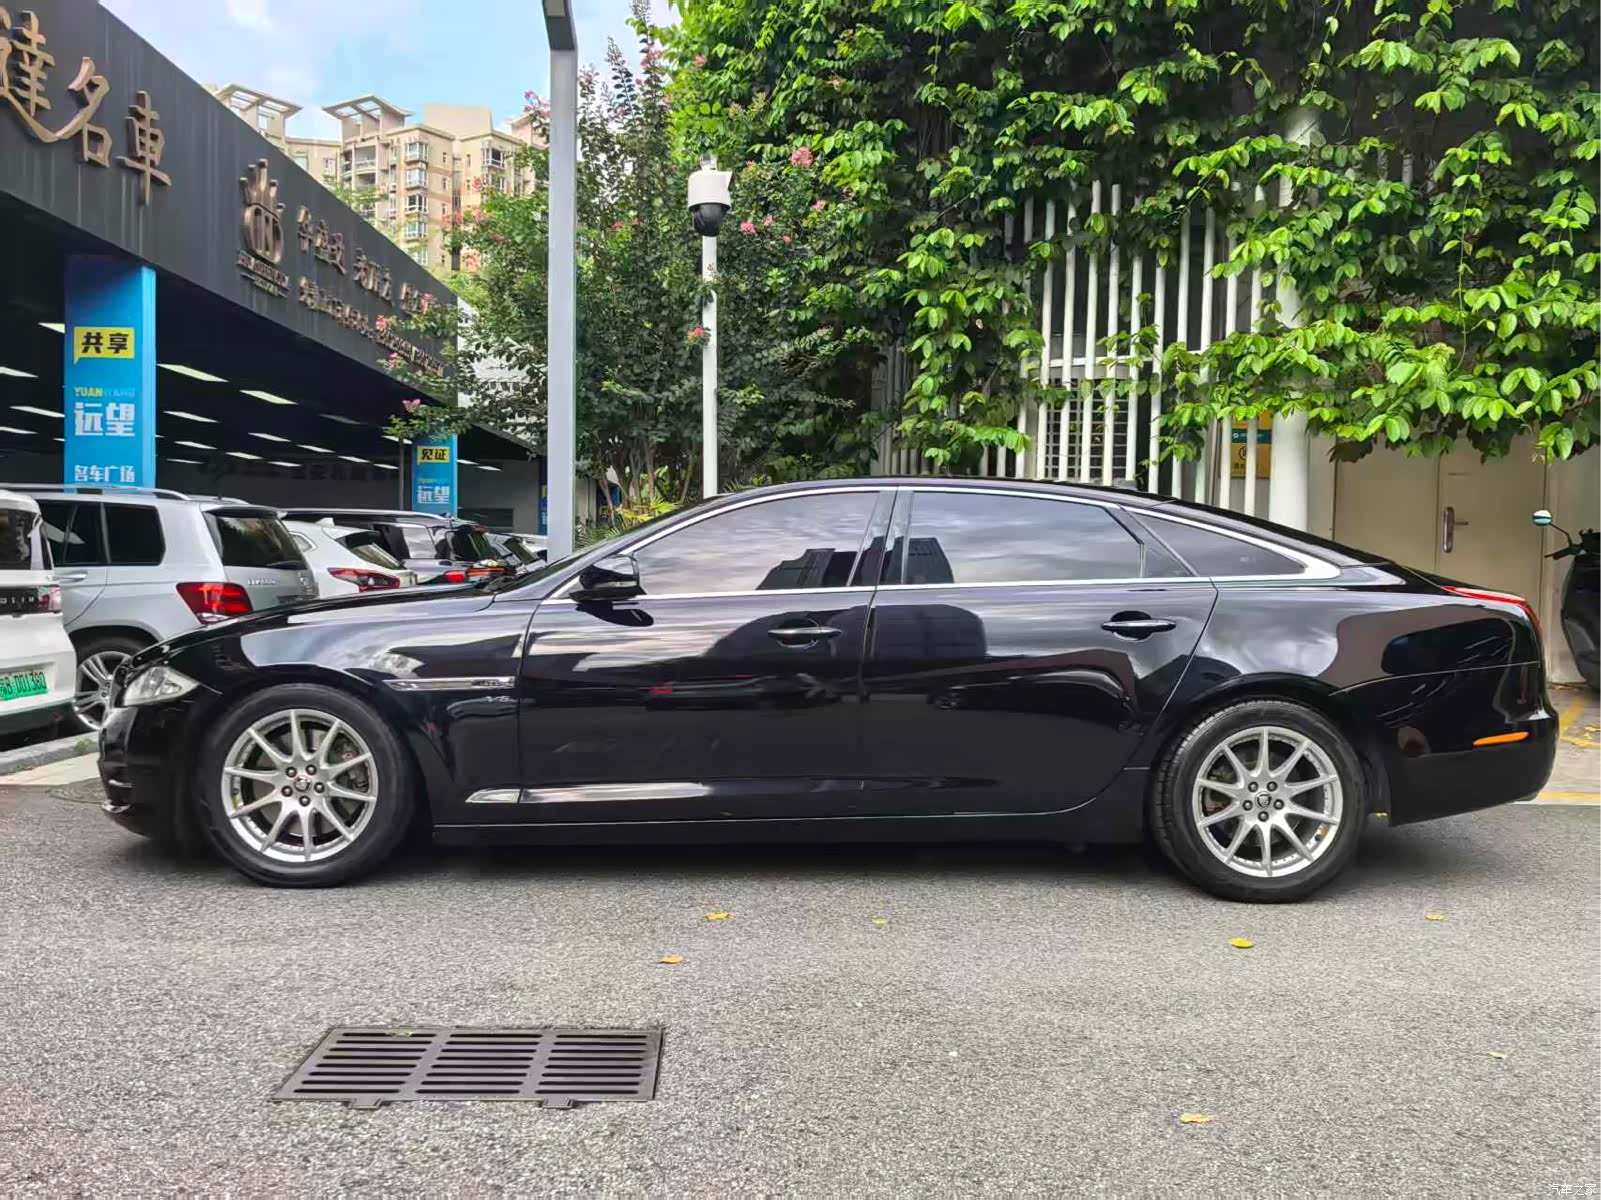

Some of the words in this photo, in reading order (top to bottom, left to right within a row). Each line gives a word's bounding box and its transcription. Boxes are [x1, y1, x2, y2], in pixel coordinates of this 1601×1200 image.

[81, 332, 129, 354] 共享
[74, 402, 136, 437] 远望
[421, 448, 446, 460] 见证
[74, 465, 136, 482] 名车广场
[417, 485, 450, 504] 远望
